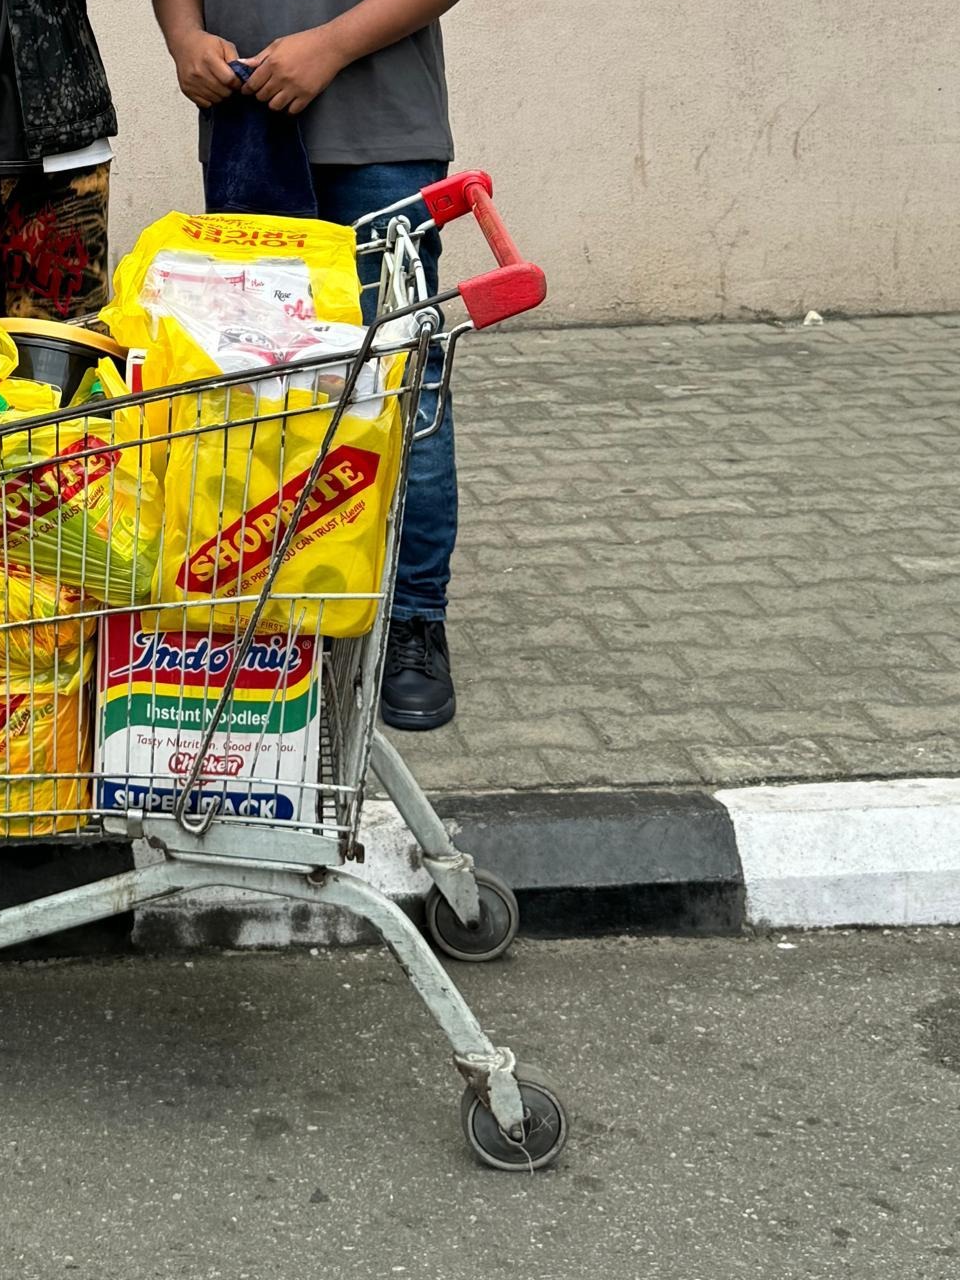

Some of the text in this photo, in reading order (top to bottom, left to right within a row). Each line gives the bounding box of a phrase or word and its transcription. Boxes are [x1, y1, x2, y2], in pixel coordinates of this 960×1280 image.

[59, 503, 83, 524] RUST
[281, 549, 296, 564] OU
[296, 535, 315, 550] CAN
[313, 518, 339, 538] TRUST
[340, 500, 366, 527] Always
[260, 620, 284, 632] FIRST
[109, 633, 302, 677] Indomie
[146, 703, 269, 725] Instant Noodles
[136, 734, 163, 749] Tasty
[166, 737, 219, 751] Nutritn.
[223, 740, 252, 752] Good
[170, 753, 244, 775] Chcken
